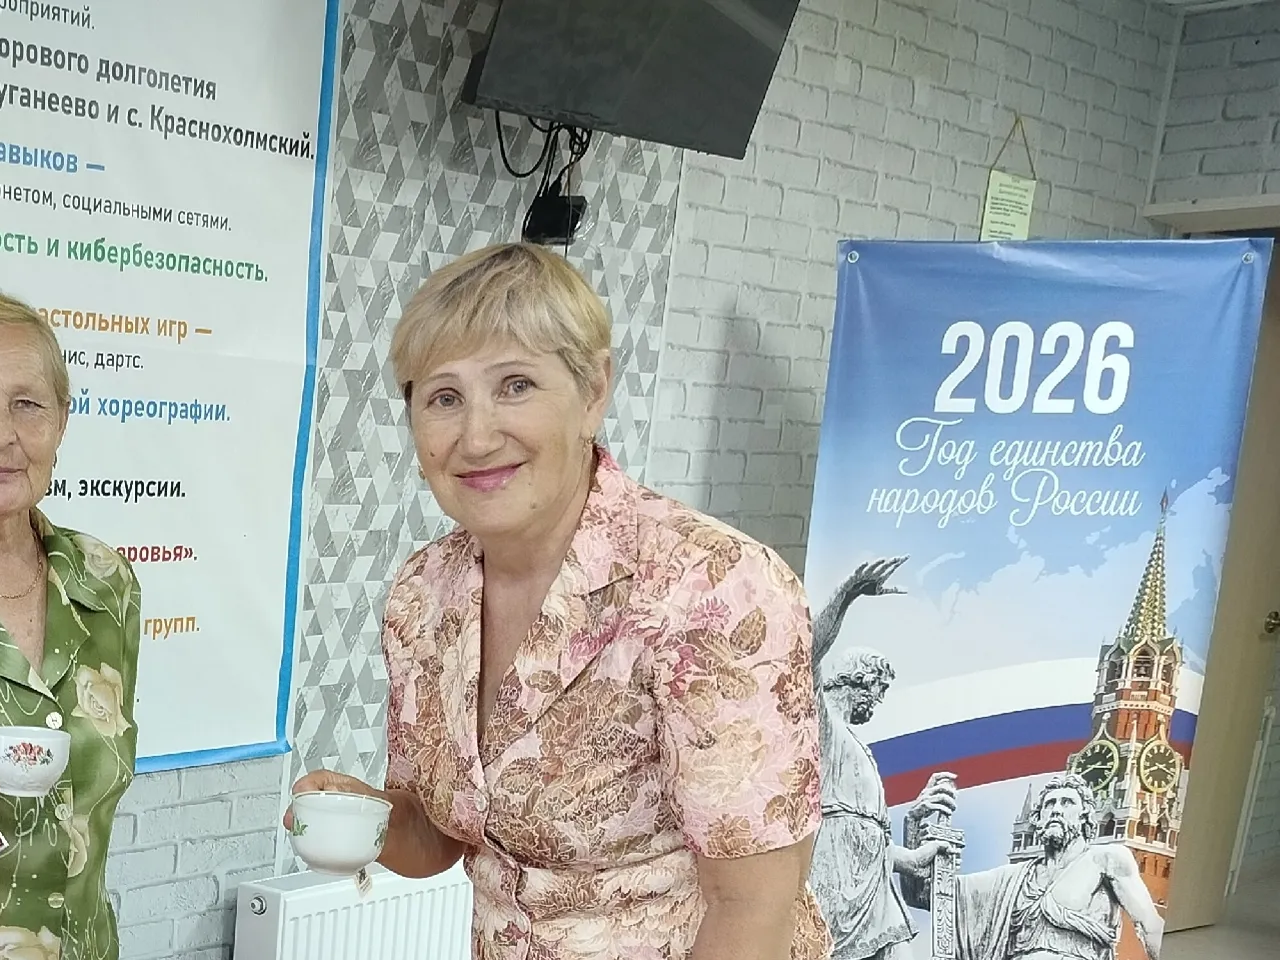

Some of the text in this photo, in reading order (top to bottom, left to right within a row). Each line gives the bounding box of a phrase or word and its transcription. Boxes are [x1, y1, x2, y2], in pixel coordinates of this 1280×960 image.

[96, 58, 217, 101] долголетия
[106, 102, 120, 124] и
[127, 106, 143, 129] с.
[150, 103, 315, 160] Краснохолмский.
[62, 191, 172, 224] социальными
[177, 209, 232, 232] сетями.
[47, 237, 60, 258] и
[67, 236, 269, 283] кибербезопасность.
[34, 307, 150, 335] астольных
[157, 317, 188, 344] игр
[94, 352, 144, 373] дартс.
[934, 320, 1135, 415] 2026
[97, 396, 231, 425] хореографии.
[895, 417, 1146, 481] Год единства
[78, 479, 186, 503] экскурсии.
[866, 468, 1143, 529] народов России
[143, 616, 200, 641] групп.
